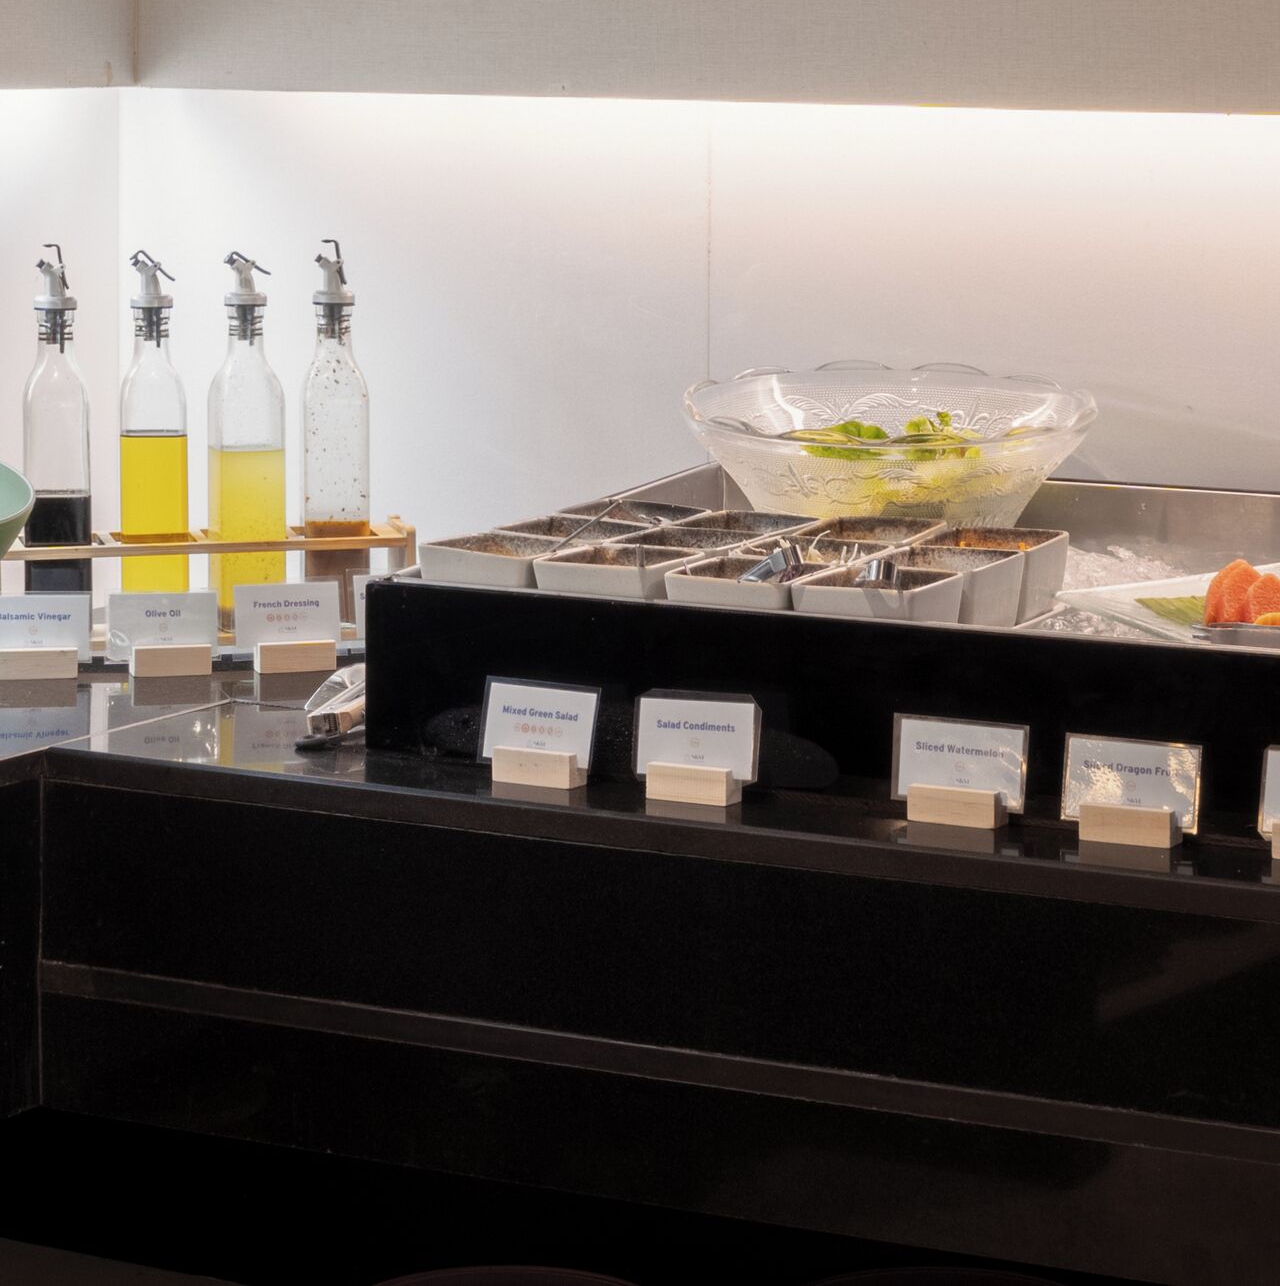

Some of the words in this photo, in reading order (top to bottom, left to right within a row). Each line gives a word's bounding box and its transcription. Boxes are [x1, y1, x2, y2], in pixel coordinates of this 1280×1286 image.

[253, 600, 282, 609] French
[284, 599, 320, 608] Dressing
[38, 612, 71, 622] Vinegar
[145, 610, 167, 618] Olive
[169, 609, 181, 617] Oil
[502, 705, 527, 716] Mixed
[529, 708, 553, 719] Green
[555, 711, 579, 722] Salad
[656, 719, 681, 729] Salad
[683, 721, 736, 732] Condiments
[915, 741, 945, 752] Sliced
[947, 744, 1004, 758] Watermelon
[1116, 763, 1152, 775] Dragon
